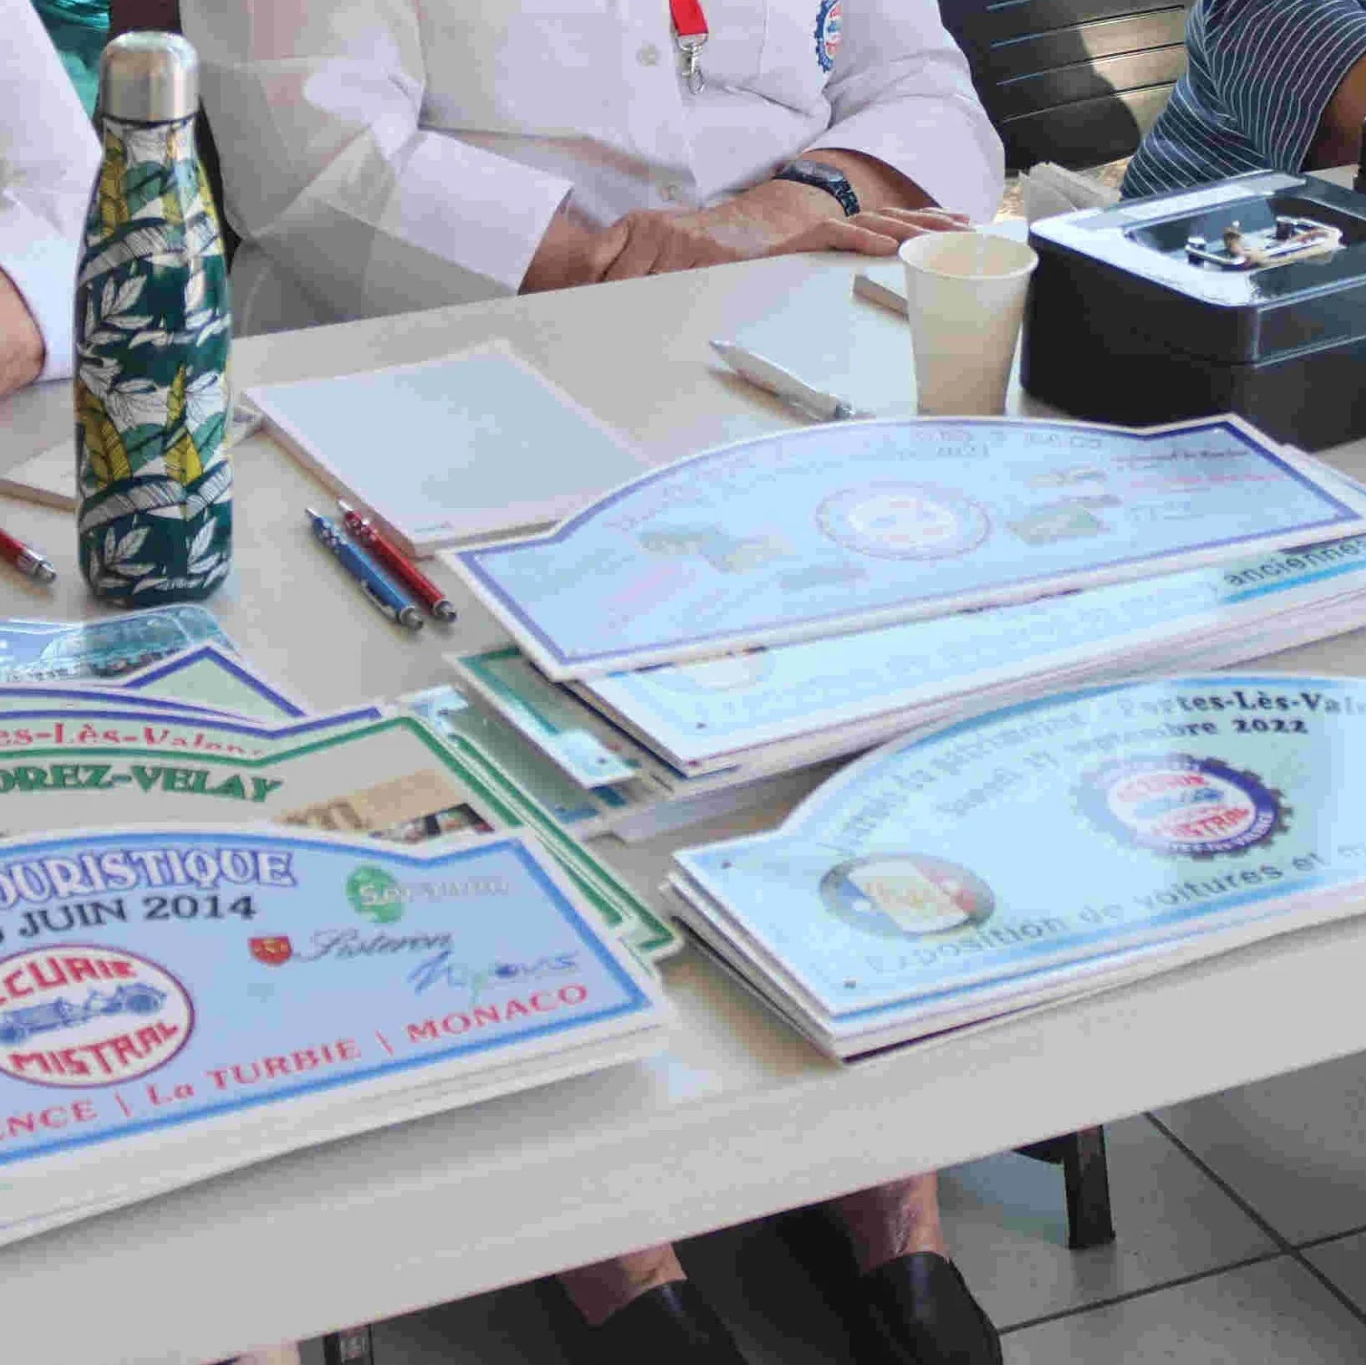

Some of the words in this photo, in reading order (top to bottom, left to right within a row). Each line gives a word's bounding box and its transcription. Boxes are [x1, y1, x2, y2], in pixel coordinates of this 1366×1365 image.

[1231, 718, 1309, 735] 2022
[1134, 859, 1284, 913] voitures
[1291, 848, 1331, 872] et
[19, 898, 129, 938] JUIN
[142, 893, 257, 922] 2014
[7, 1018, 179, 1076] MISTRAL
[146, 1081, 196, 1107] La
[204, 1038, 364, 1092] TURBIE
[404, 982, 590, 1045] MONACO
